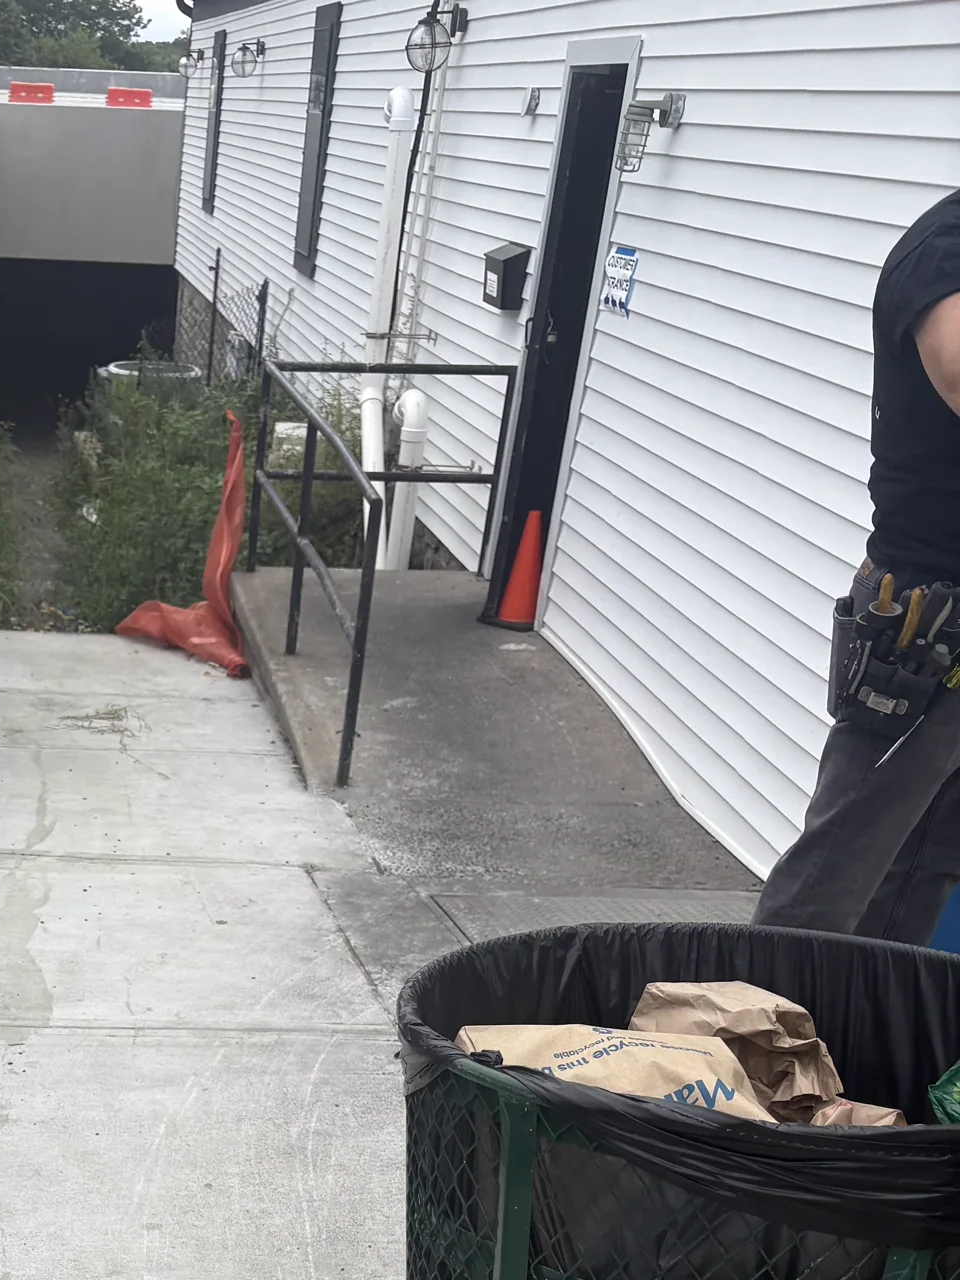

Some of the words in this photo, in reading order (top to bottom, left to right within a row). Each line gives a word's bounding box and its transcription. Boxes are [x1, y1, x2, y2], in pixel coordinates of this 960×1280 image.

[553, 1038, 605, 1060] recyclable
[592, 1040, 656, 1059] recycle
[557, 1056, 590, 1072] this
